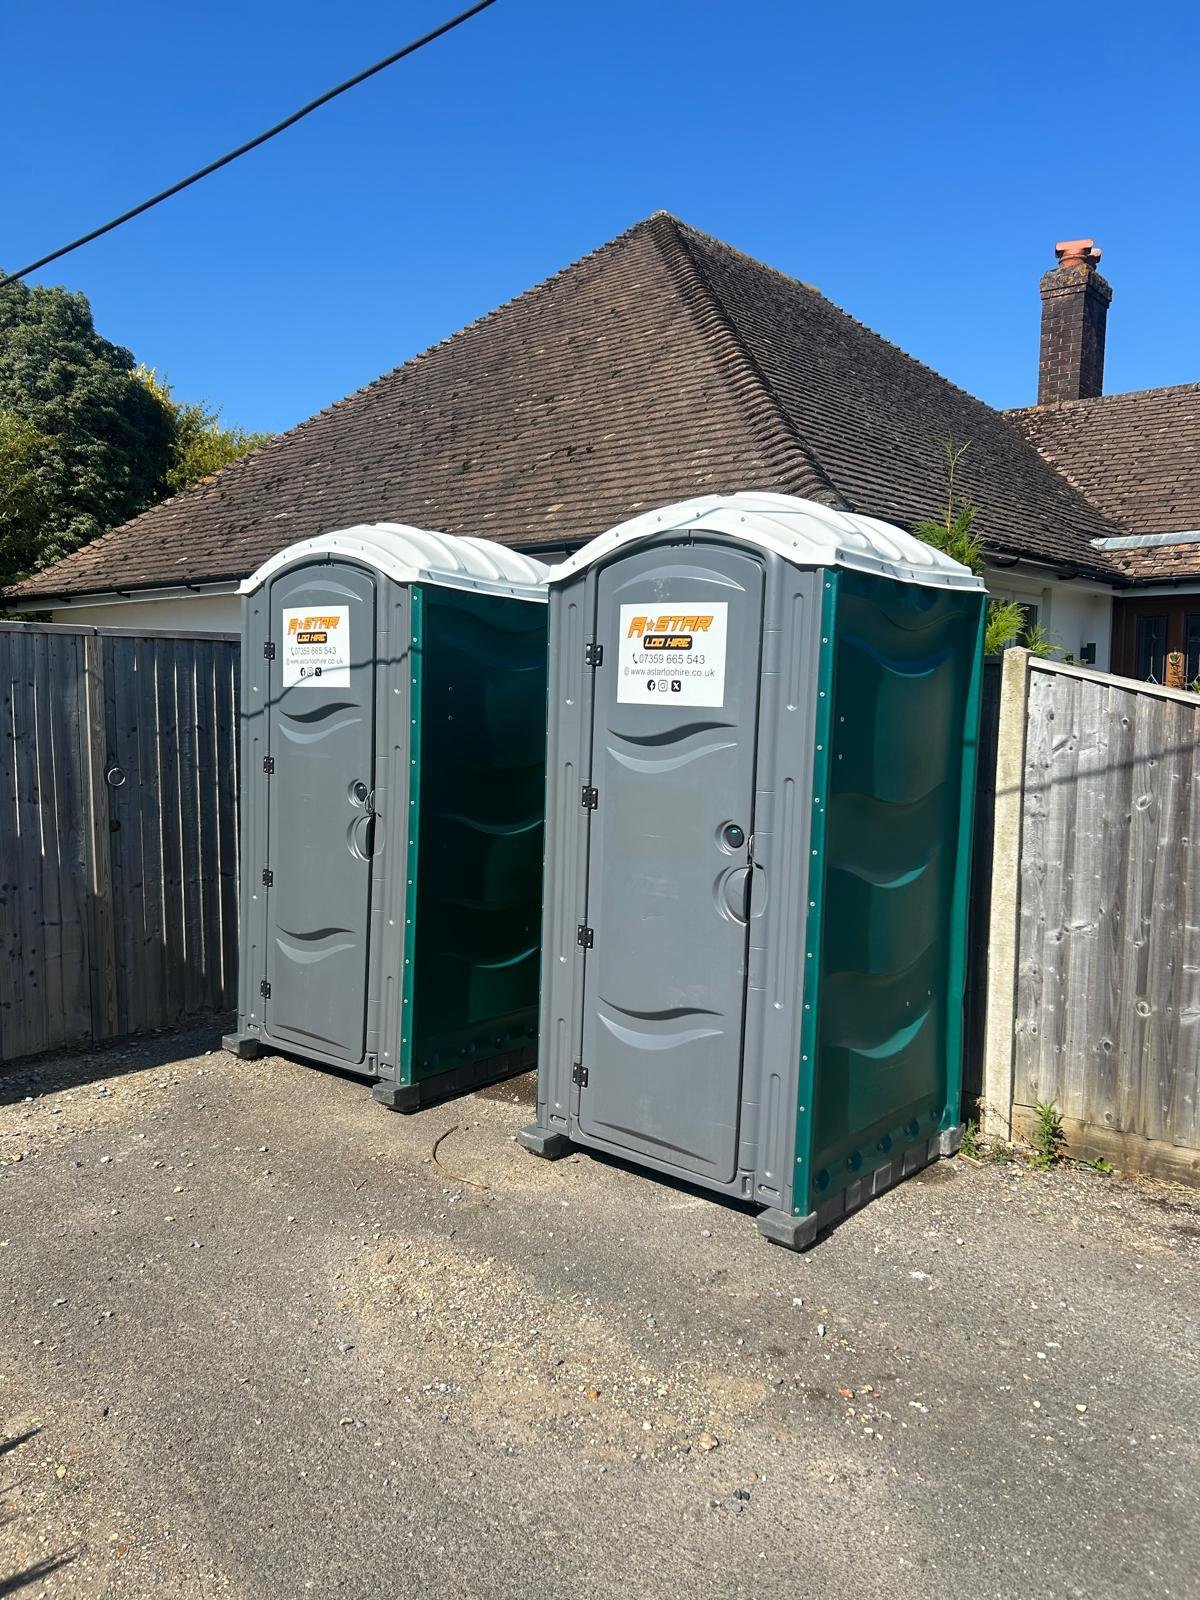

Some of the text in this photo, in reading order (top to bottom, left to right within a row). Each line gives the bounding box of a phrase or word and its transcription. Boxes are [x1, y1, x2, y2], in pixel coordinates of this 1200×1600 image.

[298, 634, 310, 642] LOO
[645, 637, 691, 647] LOO HIRE
[324, 646, 336, 655] 543
[639, 654, 706, 664] 07359 665 543
[630, 667, 715, 677] www.astarloohire.co.uk
